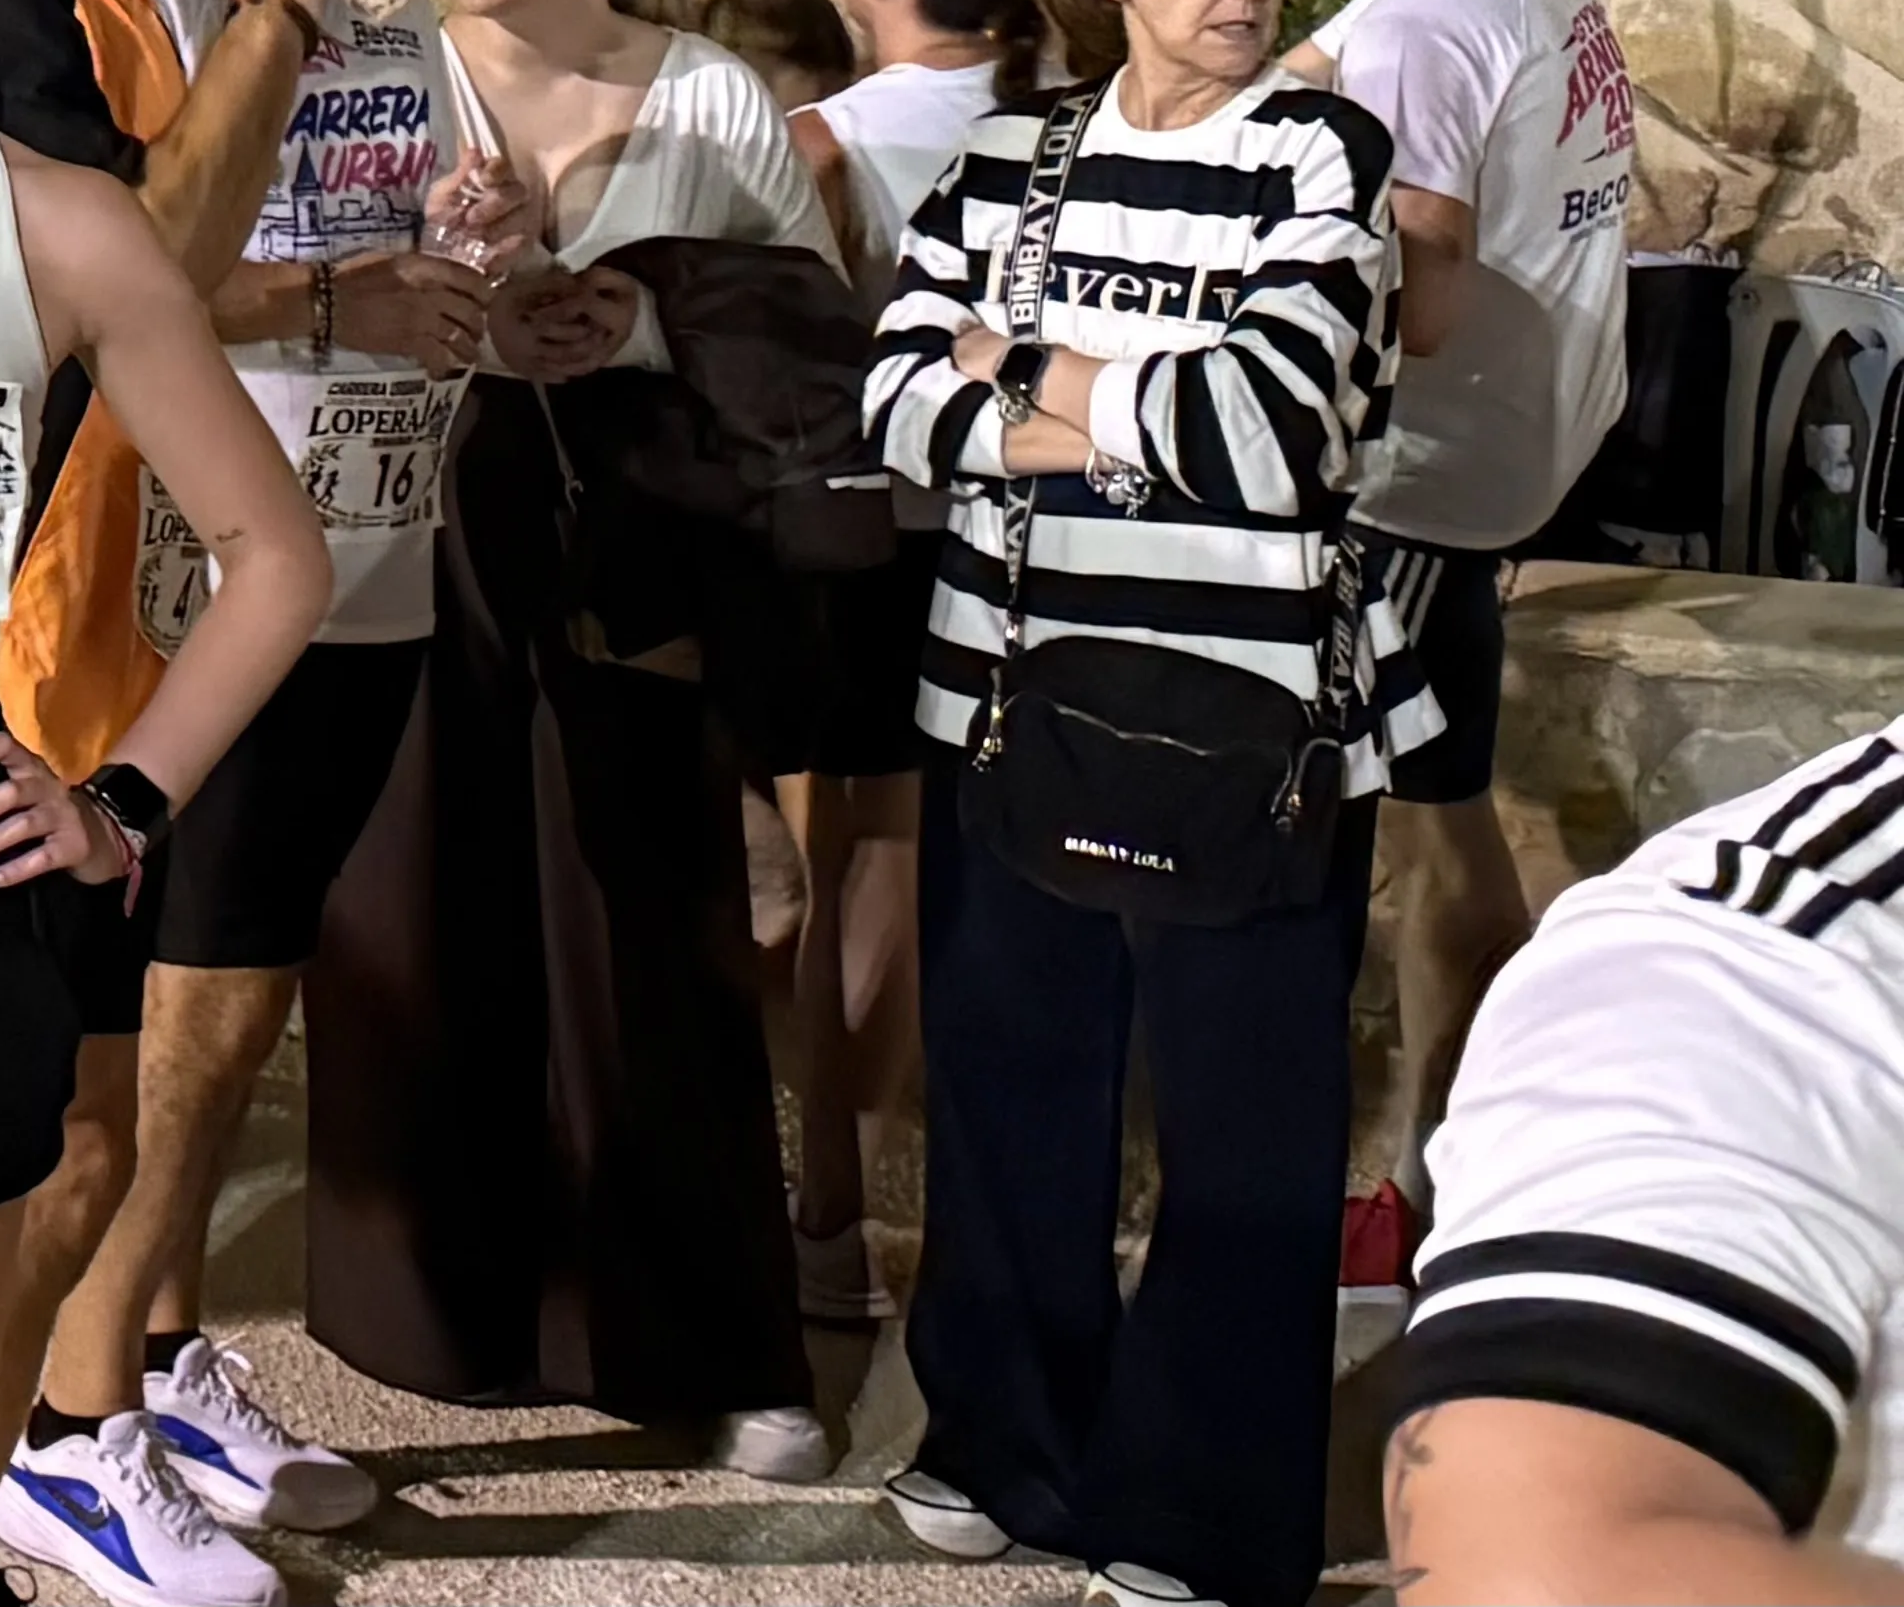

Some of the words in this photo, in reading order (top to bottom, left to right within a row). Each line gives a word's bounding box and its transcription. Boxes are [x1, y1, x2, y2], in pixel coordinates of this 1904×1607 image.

[284, 84, 430, 146] ARRERA
[321, 140, 437, 195] URBAN
[1558, 173, 1630, 231] Beco
[306, 406, 419, 438] LOPERA
[373, 450, 417, 509] 16
[172, 565, 196, 627] 4
